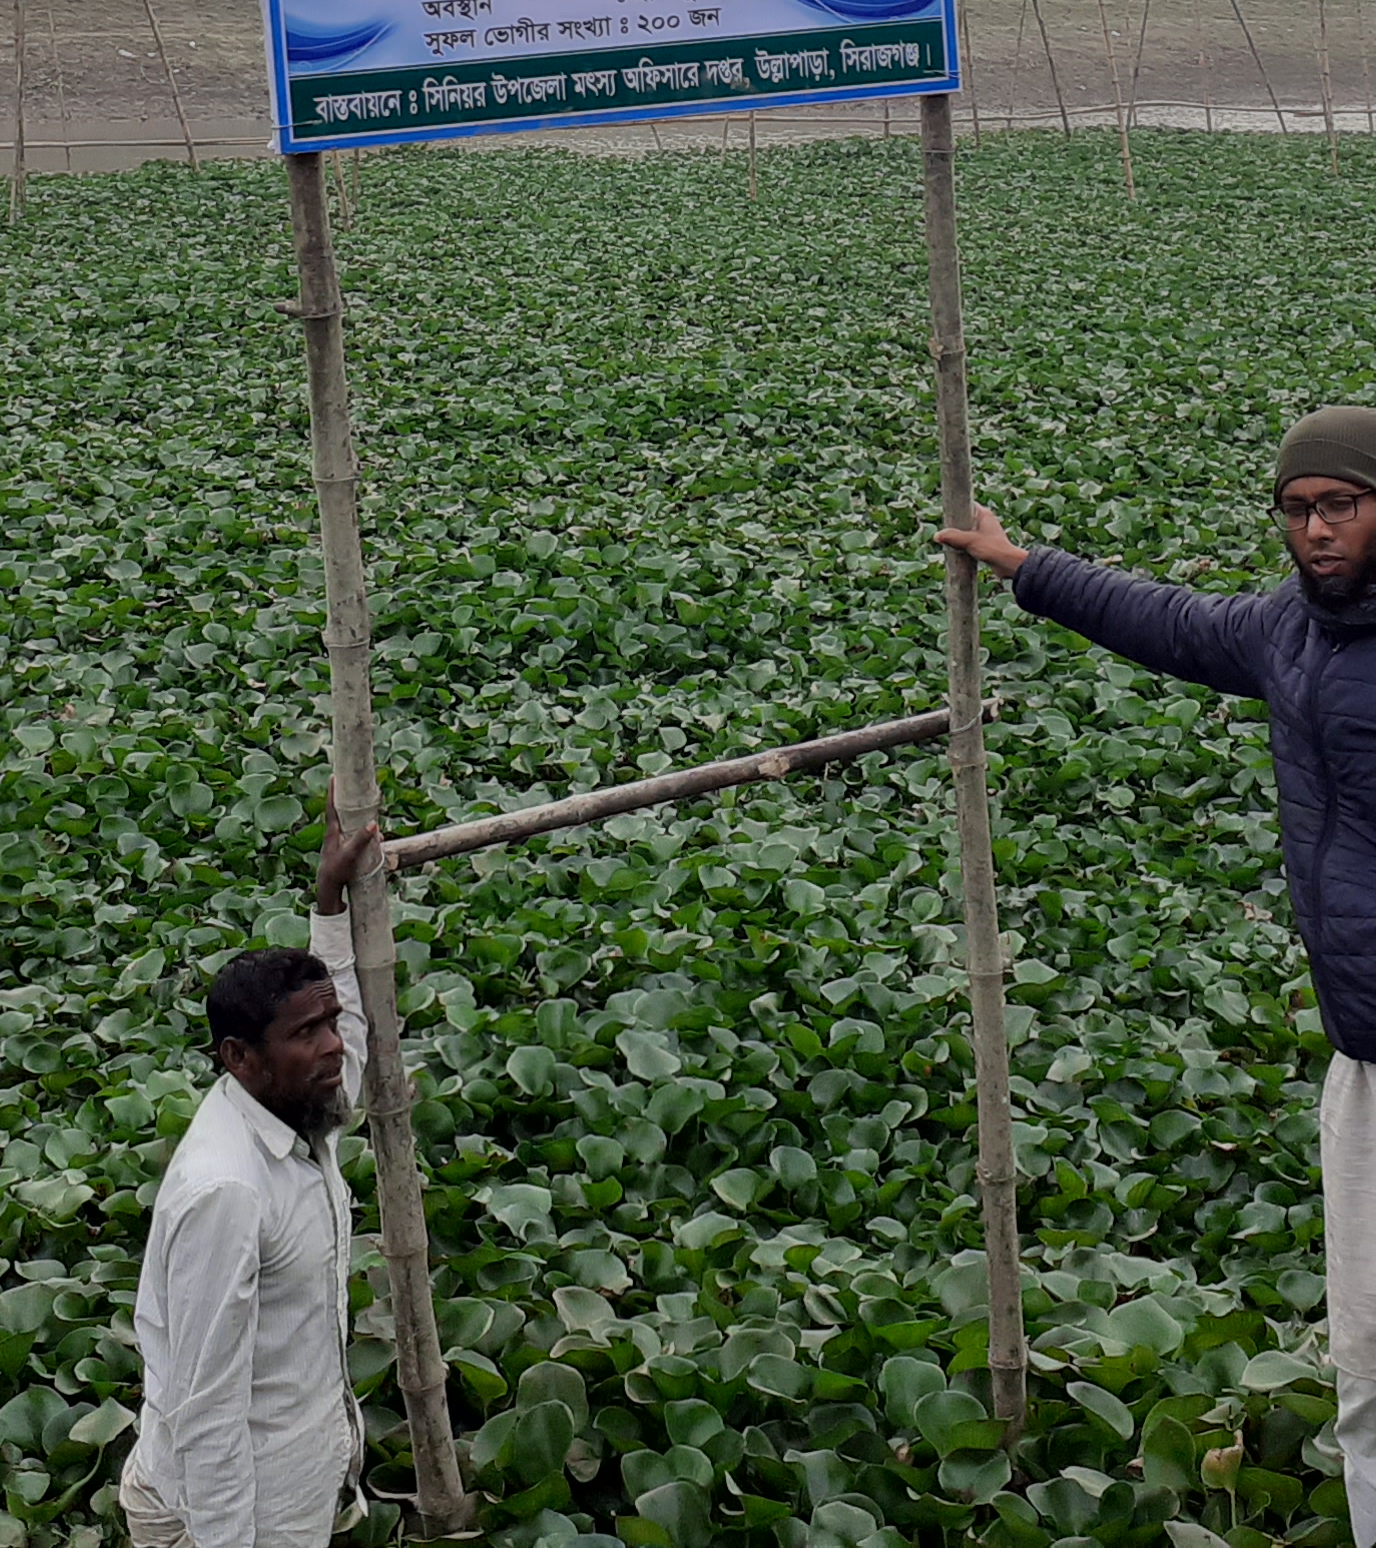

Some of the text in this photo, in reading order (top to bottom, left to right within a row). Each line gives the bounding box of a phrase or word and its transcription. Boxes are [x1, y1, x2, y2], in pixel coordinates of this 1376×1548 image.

[423, 29, 477, 56] সুফল
[484, 17, 551, 46] ভোগীর
[556, 15, 613, 40] সংখ্যা
[637, 13, 680, 35] ২০০
[687, 7, 722, 28] জন
[312, 88, 402, 124] বাস্তবায়নে
[422, 75, 487, 114] সিনিয়র
[490, 71, 567, 104] উপজেলা
[572, 68, 617, 98] মৎস্য
[755, 47, 835, 83] উল্লাপাড়া,
[839, 38, 920, 74] সিরাজগঞ্জ
